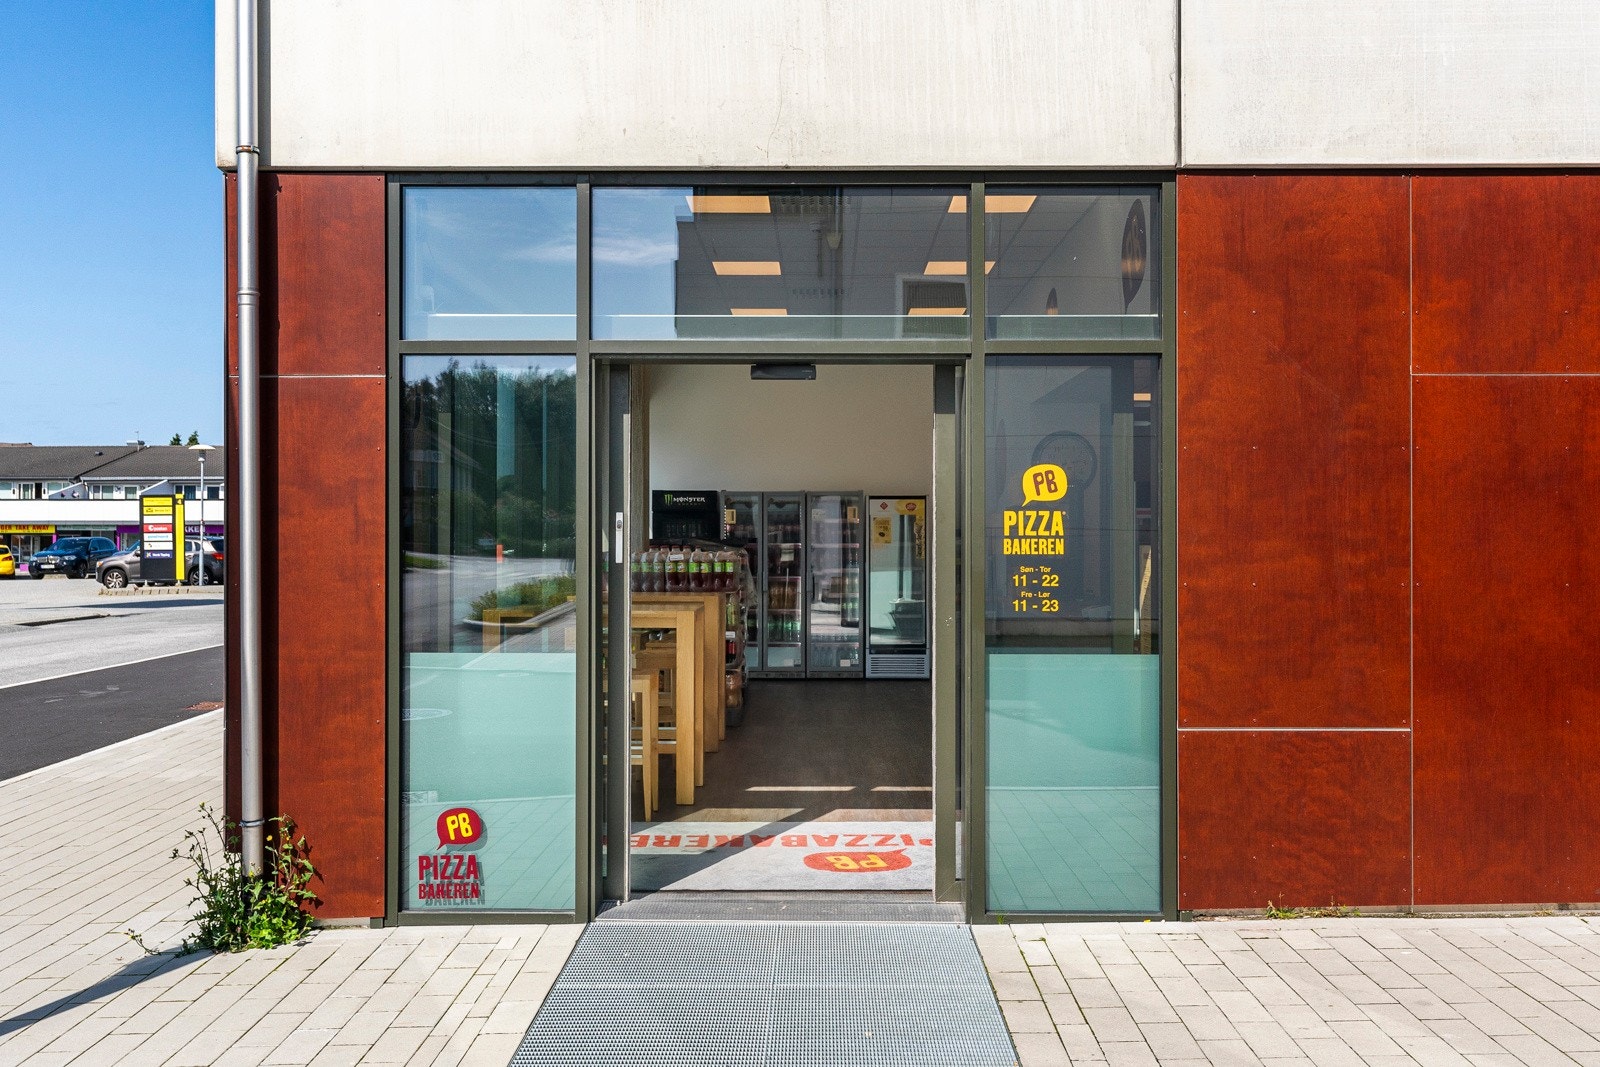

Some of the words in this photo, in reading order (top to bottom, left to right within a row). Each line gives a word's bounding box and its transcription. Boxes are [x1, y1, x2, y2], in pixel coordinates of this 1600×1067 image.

[1033, 470, 1058, 496] PB
[1003, 510, 1064, 536] PIZZA
[1003, 538, 1064, 555] BAKEREN
[1012, 574, 1027, 587] 11
[1041, 574, 1059, 587] 22
[1012, 599, 1027, 612] 11
[1041, 599, 1059, 612] 23
[446, 812, 473, 841] PB
[418, 854, 479, 881] PIZZA
[825, 853, 888, 870] PB
[418, 883, 480, 900] BAKEREN
